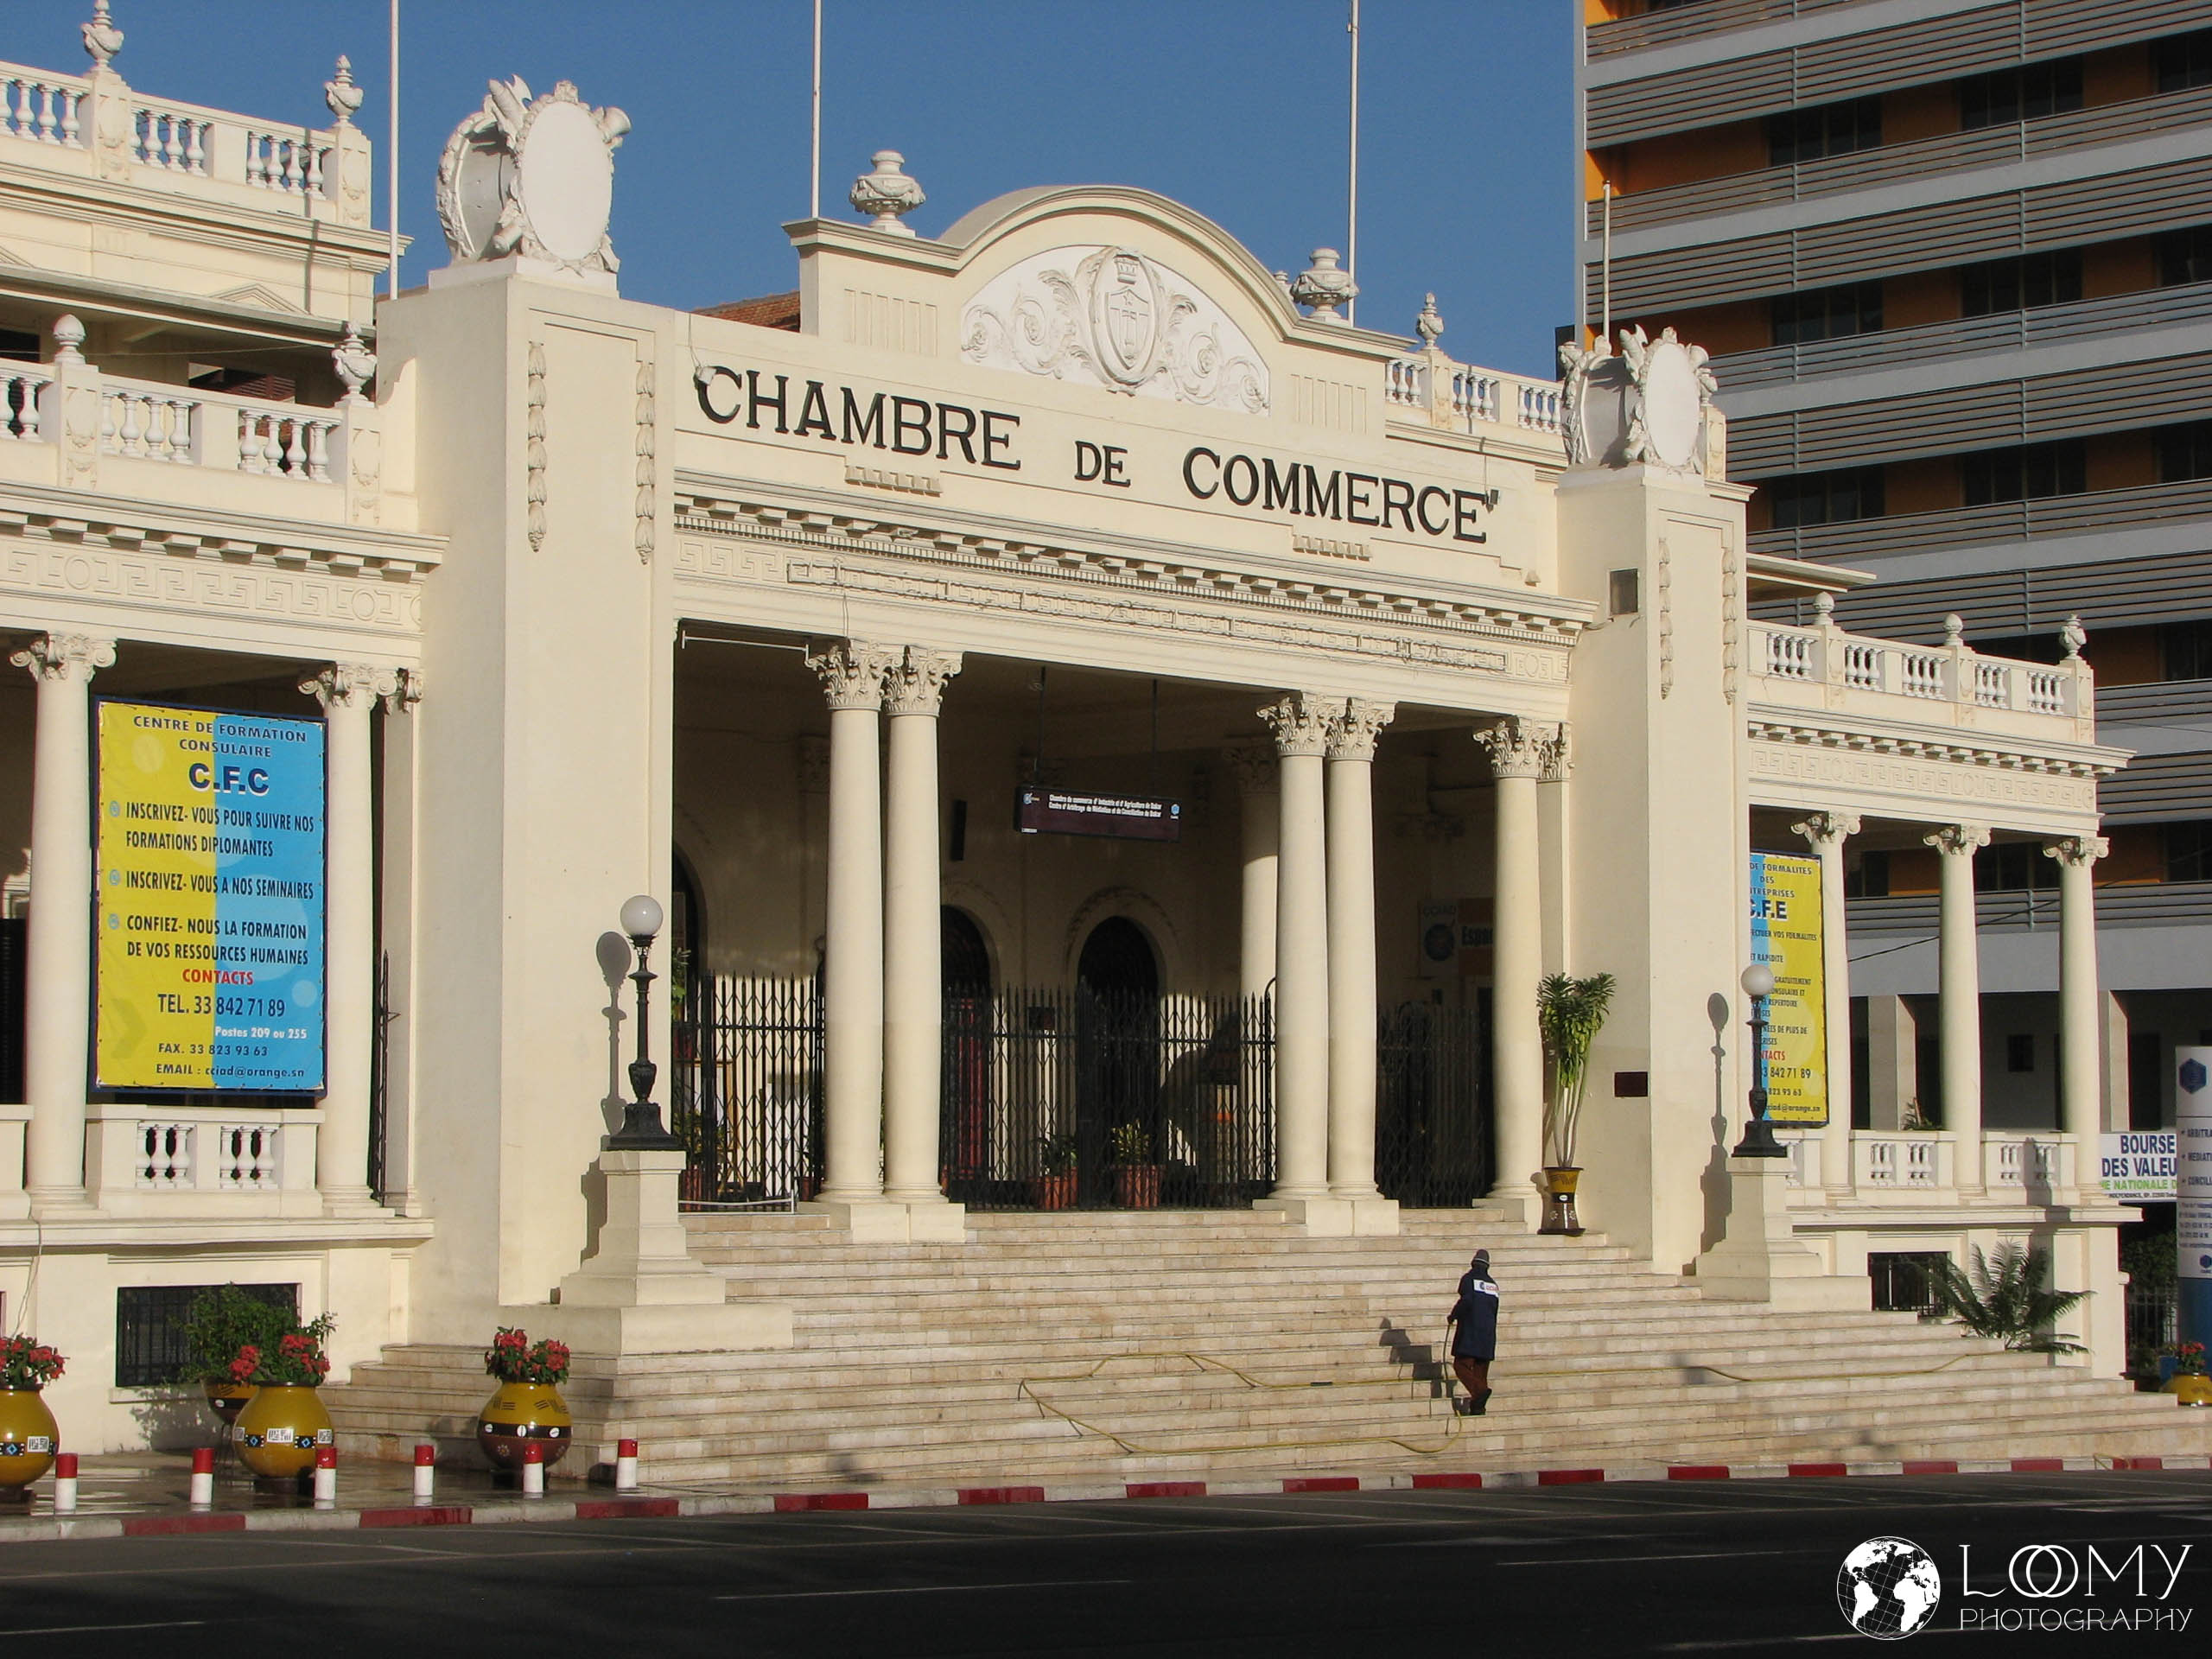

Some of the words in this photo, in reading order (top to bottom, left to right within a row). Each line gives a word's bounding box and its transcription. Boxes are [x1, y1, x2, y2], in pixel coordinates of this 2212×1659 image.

[694, 365, 1021, 471] CHAMBRE
[1074, 441, 1131, 487] DE
[1182, 446, 1488, 544] COMMERCE
[133, 715, 189, 731] CENTRE
[195, 721, 213, 733] DE
[219, 723, 307, 742] FORMATION
[179, 739, 271, 758] CONSULAIRE
[188, 762, 270, 795] C.F.C
[192, 807, 220, 825] VOUS
[223, 810, 252, 828] POUR
[256, 812, 291, 830] SUIVRE
[294, 815, 315, 832] NOS
[126, 830, 198, 852] FORMATIONS
[201, 836, 274, 857] DIPLOMANTES
[1763, 863, 1812, 875] FORMALITES
[190, 874, 218, 893] VOUS
[221, 877, 229, 894] A
[232, 878, 253, 896] NOS
[256, 880, 315, 899] SEMINAIRES
[1760, 875, 1775, 884] DES
[187, 918, 220, 935] NOUS
[225, 920, 238, 936] LA
[241, 921, 307, 940] FORMATION
[1751, 929, 1771, 938] ECTUER
[127, 941, 142, 957] DE
[146, 943, 170, 958] VOS
[175, 944, 246, 963] RESSOURCES
[250, 948, 308, 965] HUMAINES
[181, 968, 254, 985] CONTACTS
[157, 994, 189, 1014] TEL.
[194, 995, 212, 1014] 33
[216, 997, 244, 1016] 842
[248, 998, 264, 1017] 71
[268, 999, 285, 1017] 89
[214, 1026, 248, 1038] Postes
[251, 1027, 270, 1039] 209
[273, 1030, 285, 1039] ou
[287, 1028, 308, 1039] 255
[158, 1043, 185, 1054] FAX.
[189, 1044, 204, 1054] 33
[208, 1044, 231, 1056] 823
[235, 1046, 250, 1056] 93
[253, 1046, 268, 1057] 63
[156, 1064, 194, 1075] EMAIL
[1770, 1066, 1784, 1078] 842
[1786, 1067, 1796, 1078] 71
[1800, 1068, 1811, 1079] 89
[2120, 1135, 2176, 1154] BOURSE
[2101, 1157, 2129, 1177] DES
[2113, 1179, 2169, 1190] NATIONALE
